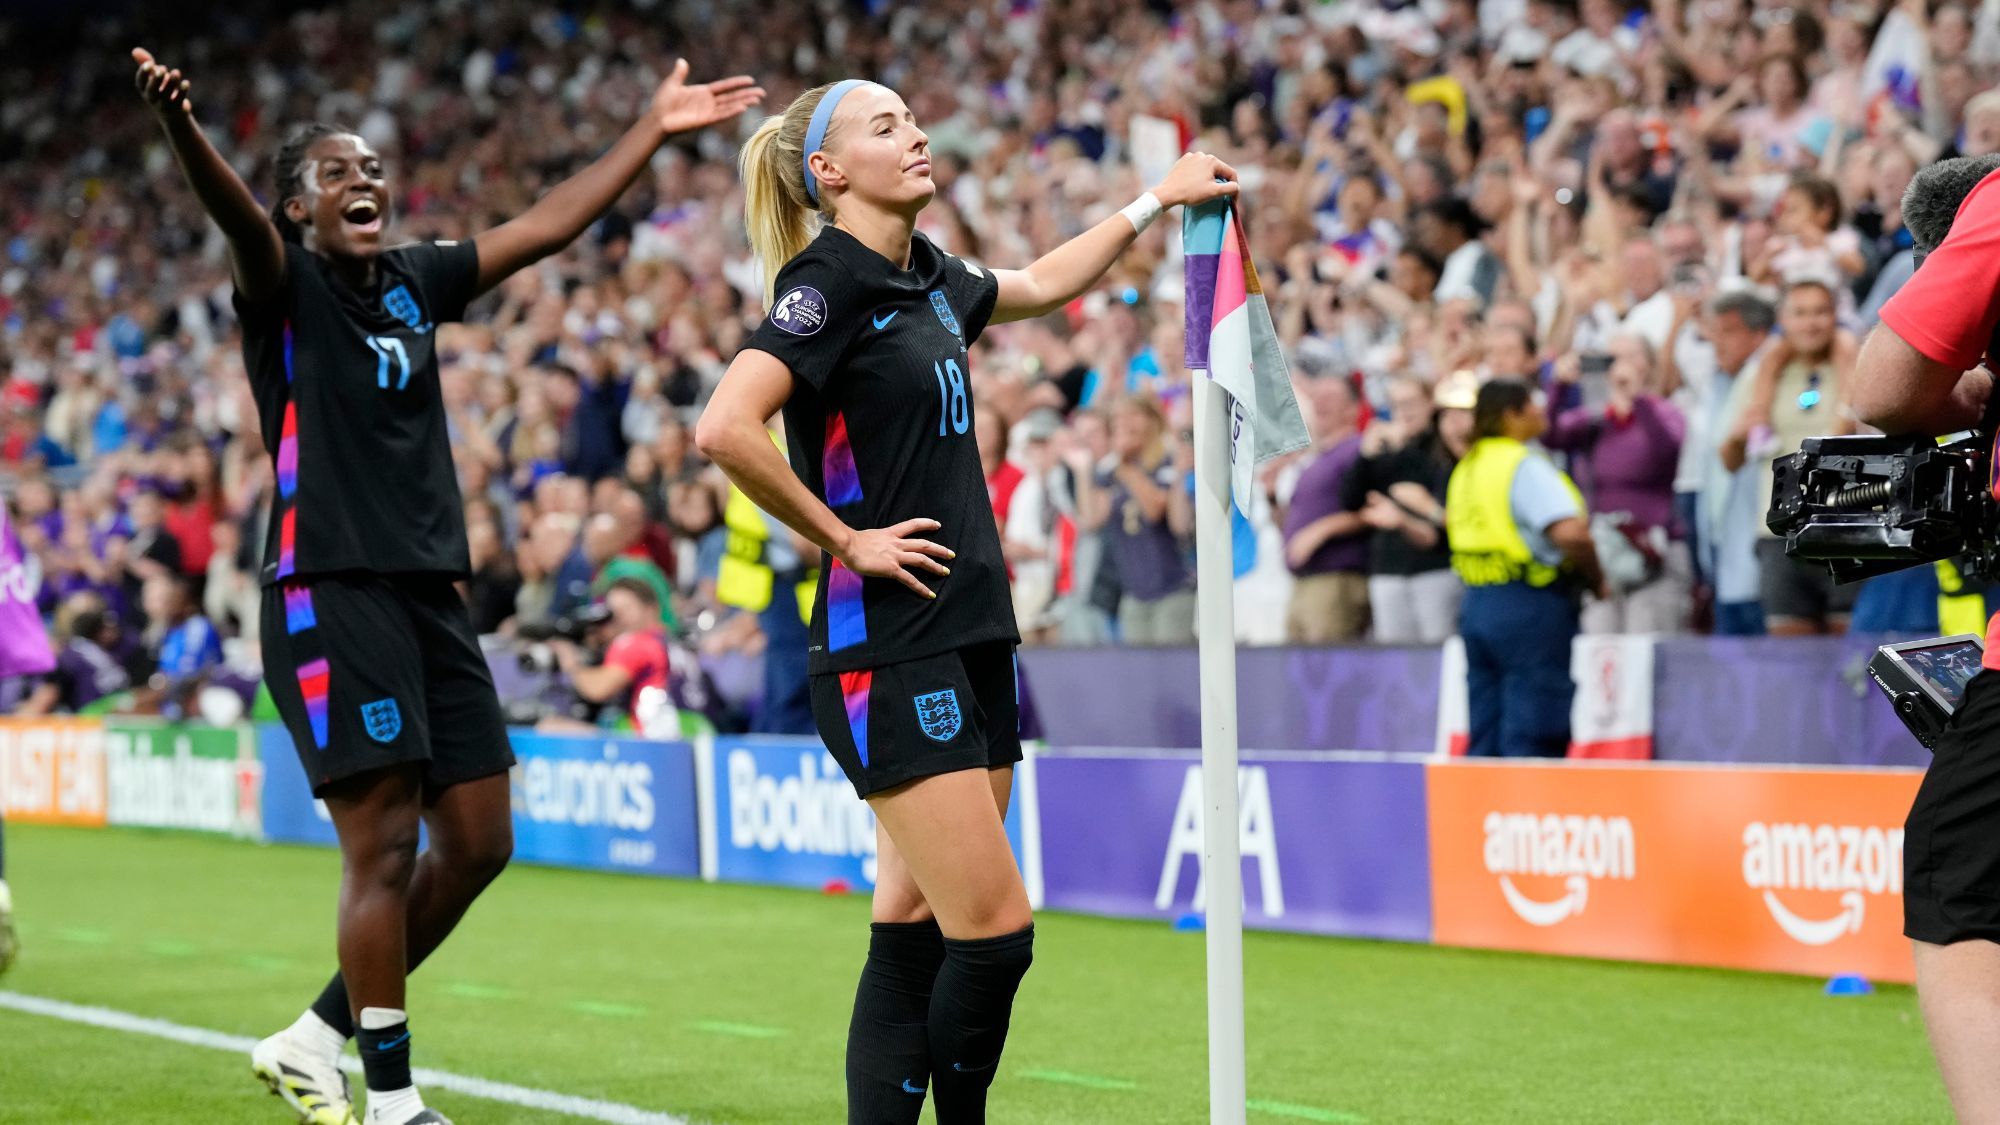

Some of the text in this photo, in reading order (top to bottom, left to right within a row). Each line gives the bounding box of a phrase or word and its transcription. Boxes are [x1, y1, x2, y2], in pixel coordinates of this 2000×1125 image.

[791, 308, 821, 325] CHAMPIONS
[794, 304, 822, 320] EUROPEAN
[794, 314, 812, 327] 2022
[366, 335, 411, 391] 17
[934, 358, 969, 437] 18
[525, 742, 655, 832] euronics
[1154, 764, 1285, 918] AA
[1483, 811, 1635, 880] amazon
[1742, 821, 1905, 895] amazon
